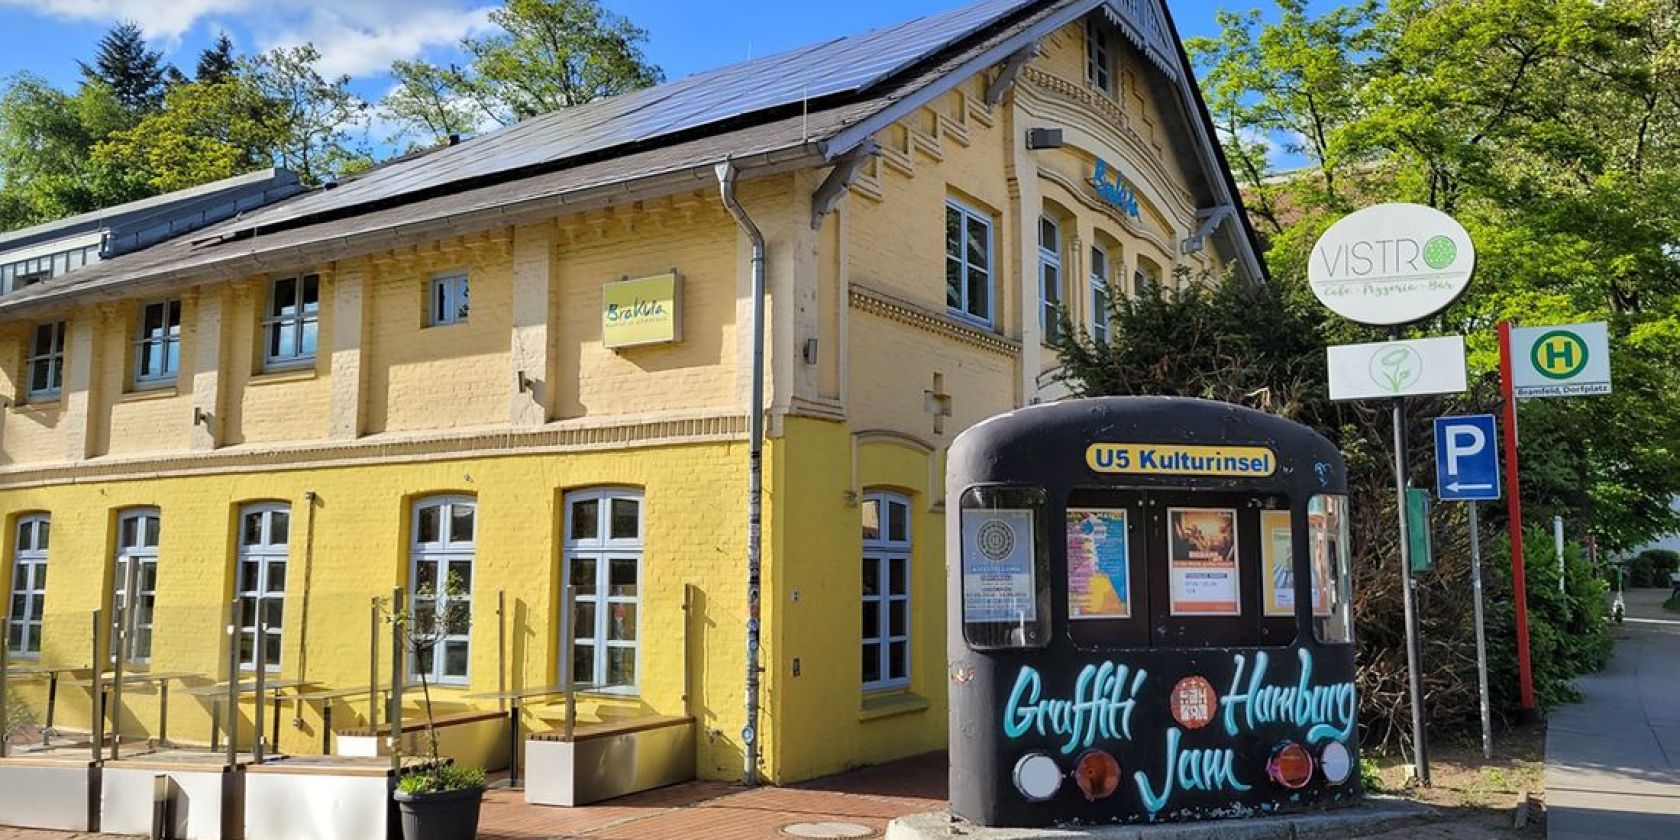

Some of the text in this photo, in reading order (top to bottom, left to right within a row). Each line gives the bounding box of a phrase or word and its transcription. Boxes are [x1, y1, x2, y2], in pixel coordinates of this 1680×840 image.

[1320, 235, 1457, 278] VISTRO
[1546, 341, 1573, 369] H
[1563, 384, 1609, 394] Dorfplatz
[1095, 448, 1269, 473] U5 Kulturinsel
[1445, 424, 1486, 476] P
[1004, 648, 1356, 755] Graffiti Hamburg
[1134, 727, 1252, 814] Jam
